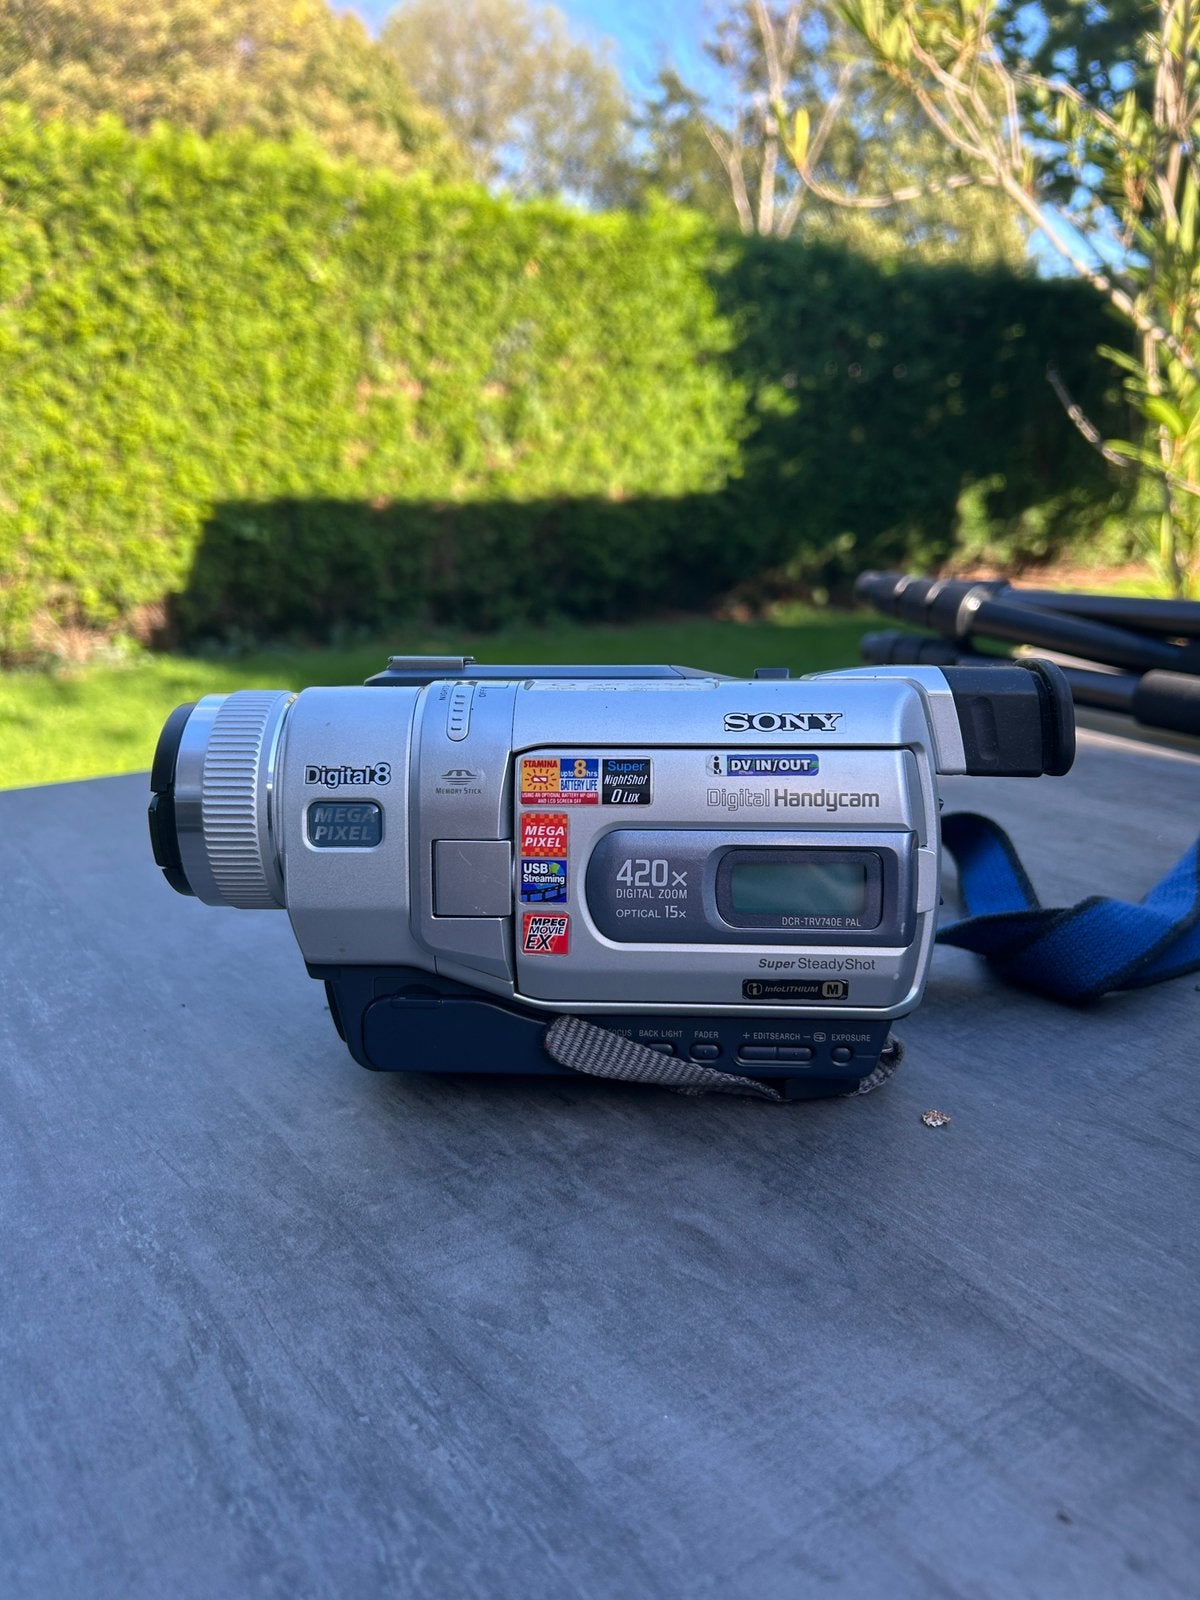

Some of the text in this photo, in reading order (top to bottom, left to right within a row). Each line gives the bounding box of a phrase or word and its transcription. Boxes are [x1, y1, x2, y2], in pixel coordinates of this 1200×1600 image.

[723, 712, 843, 732] SONY
[523, 760, 558, 768] STAMINA
[574, 759, 587, 778] 8
[607, 760, 645, 773] Super
[730, 759, 754, 771] DV
[755, 759, 811, 772] IN/OUT
[304, 762, 391, 789] Digital8
[604, 774, 648, 786] NightShot
[560, 779, 598, 791] BATTERY LIFE
[707, 789, 880, 811] Digital Handycam
[315, 807, 376, 823] MEGA
[315, 826, 371, 840] PIXEL
[525, 825, 565, 836] MEGA
[525, 837, 561, 848] PIXEL
[523, 863, 548, 874] USB
[523, 874, 565, 885] Streaming
[616, 889, 688, 899] DIGITAL ZOOM
[616, 909, 661, 918] OPTICAL
[531, 918, 566, 927] MPEG
[781, 917, 862, 927] DCR-TRV740E PAL
[529, 926, 564, 934] MOVIE
[525, 934, 552, 950] EX
[758, 957, 876, 972] Super SteadyShot
[764, 985, 819, 993] InfoLITHIUM
[826, 984, 839, 995] M
[608, 1029, 632, 1037] OCUS
[639, 1030, 683, 1038] BACK LIGHT
[694, 1031, 719, 1039] FADER
[753, 1032, 800, 1040] EDITSEARCH
[831, 1034, 871, 1042] EXPOSURE
